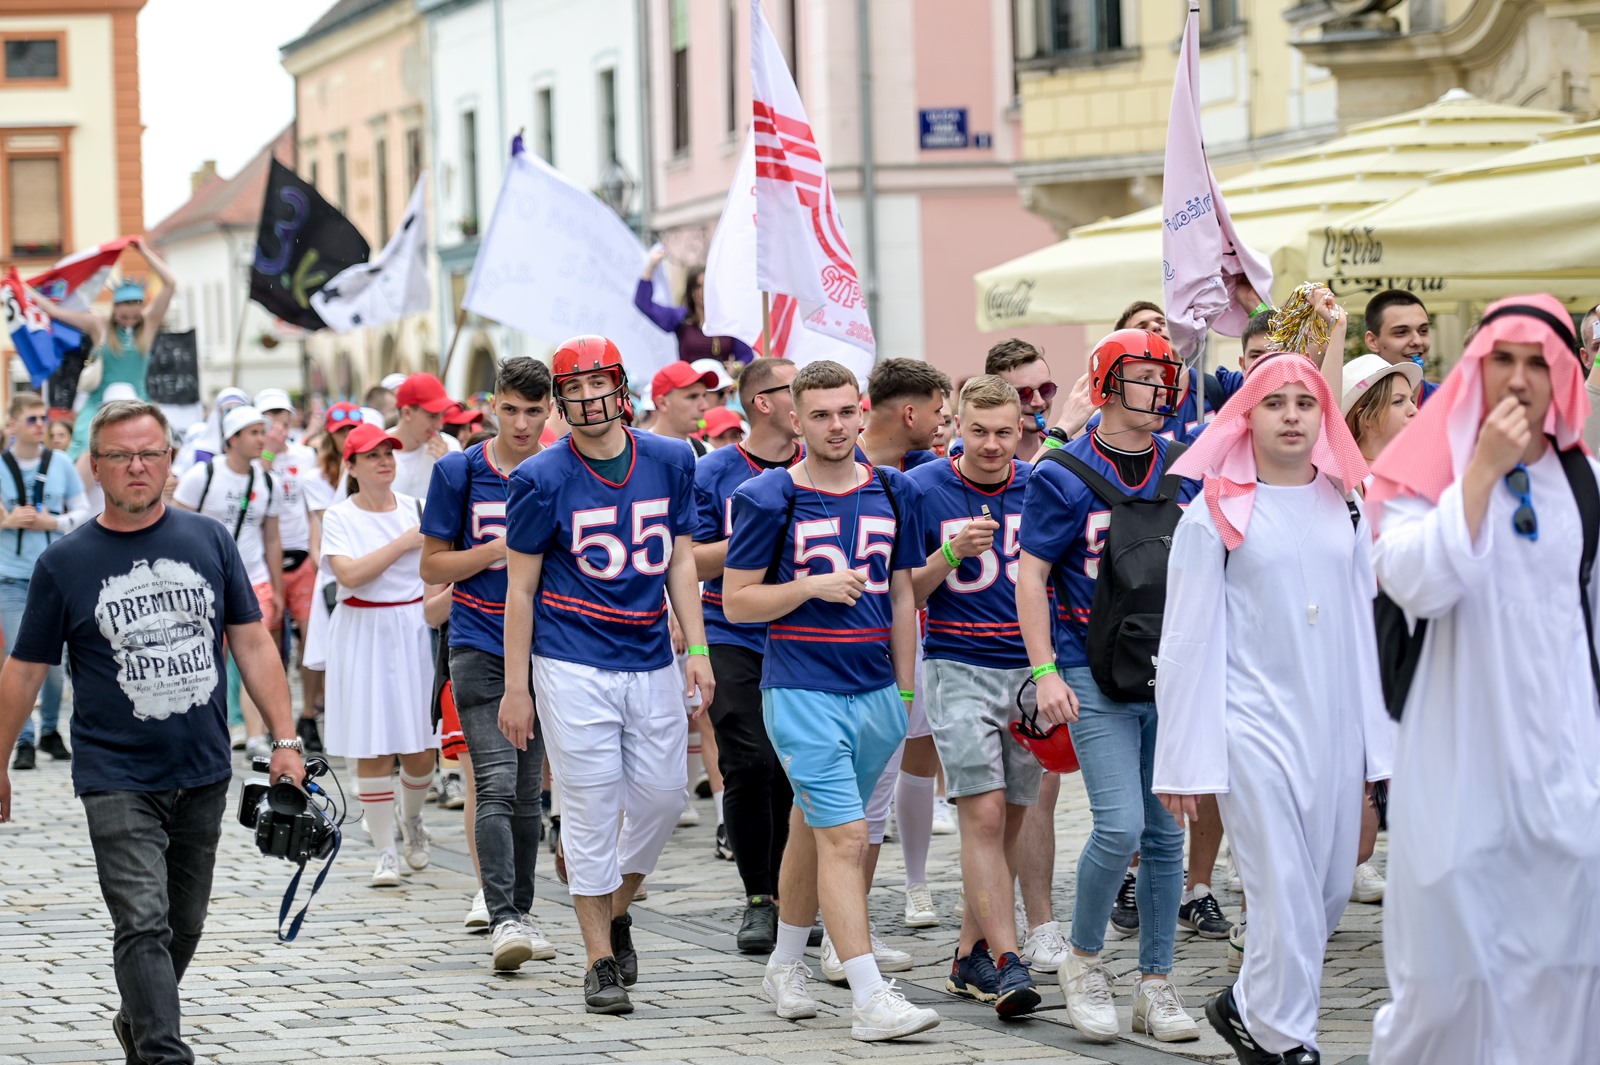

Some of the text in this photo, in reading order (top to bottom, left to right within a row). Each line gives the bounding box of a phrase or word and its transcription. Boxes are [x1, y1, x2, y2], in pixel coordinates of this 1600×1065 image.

[571, 497, 675, 580] 55
[794, 515, 897, 594] 55
[105, 587, 209, 635] PREMIUM
[123, 583, 150, 596] VINTAGE
[135, 626, 194, 645] WORK WEAR
[124, 641, 212, 681] APPAREL
